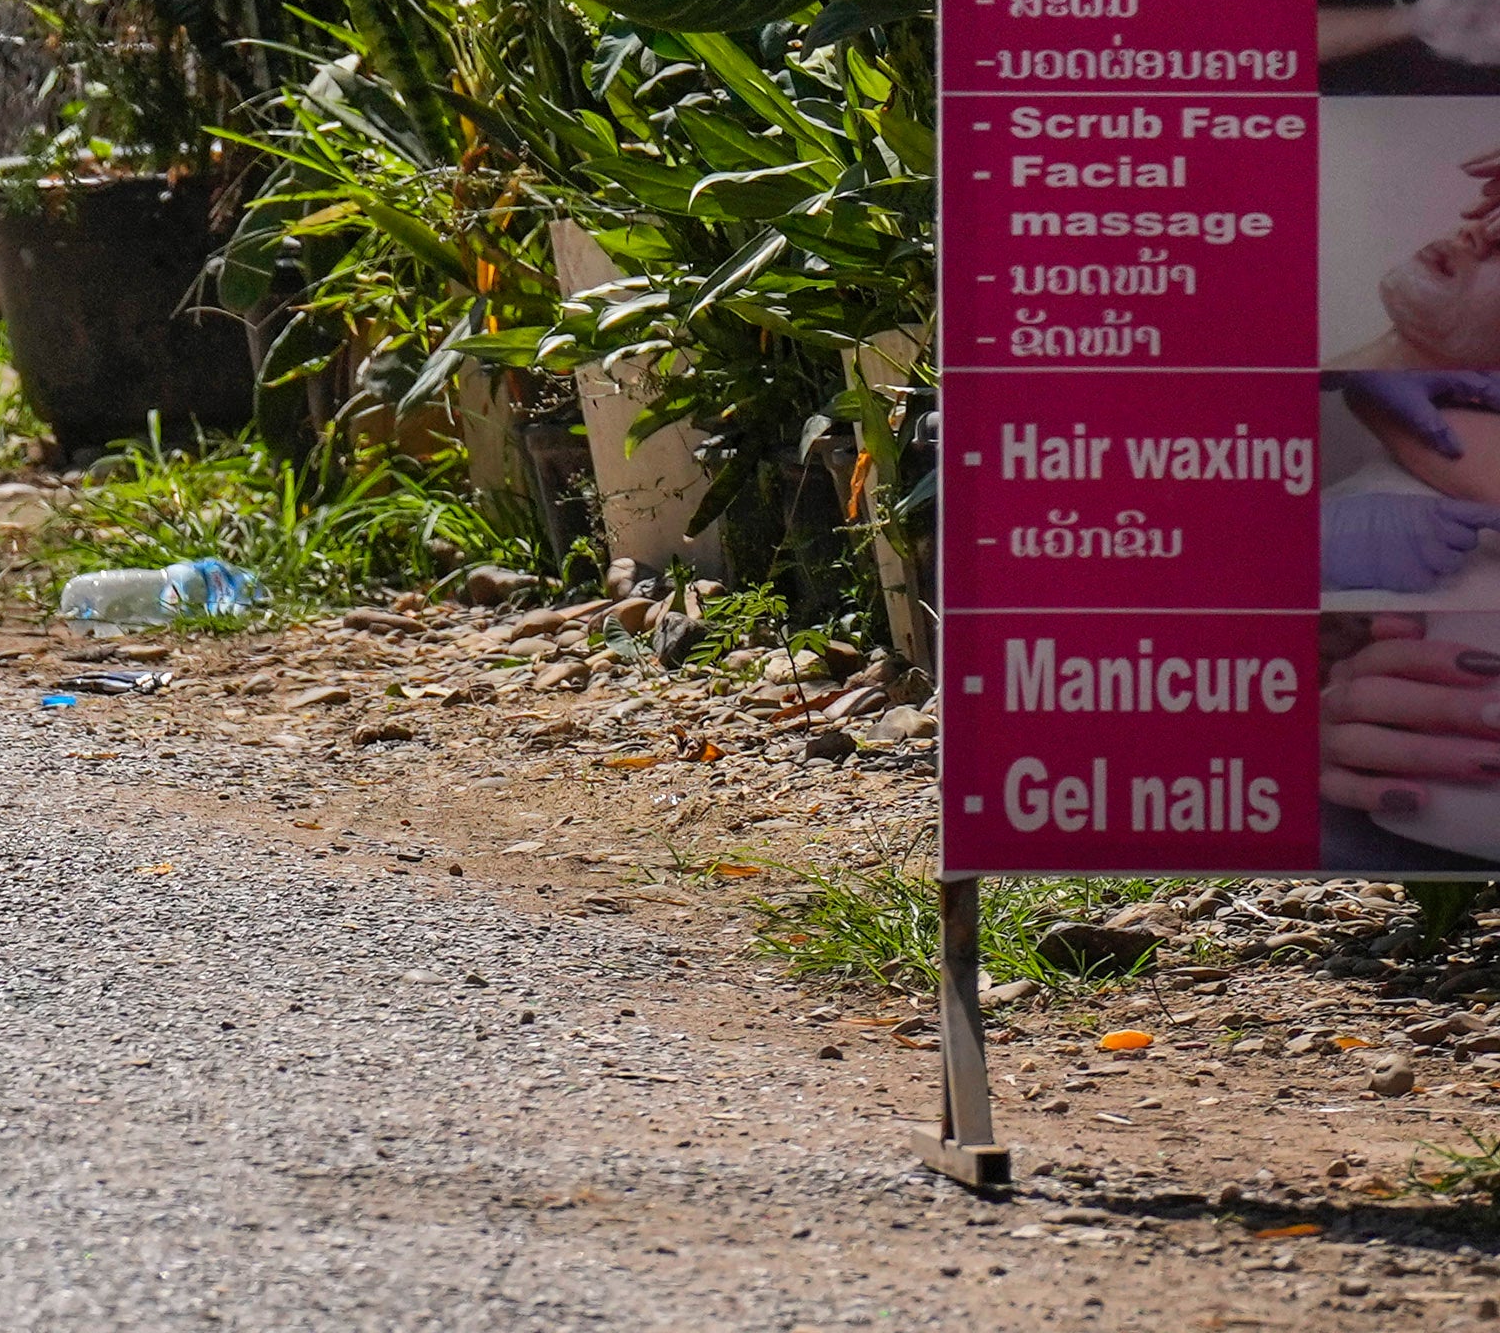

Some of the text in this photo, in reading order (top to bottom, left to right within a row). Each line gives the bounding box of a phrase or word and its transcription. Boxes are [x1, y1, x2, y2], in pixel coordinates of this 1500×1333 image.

[1010, 106, 1306, 140] Scrub Face
[1011, 155, 1186, 188] Facial
[1010, 211, 1273, 245] massage
[1002, 423, 1313, 496] Hair waxing
[1005, 638, 1298, 713] Manicure
[1003, 756, 1281, 833] Gel nails
